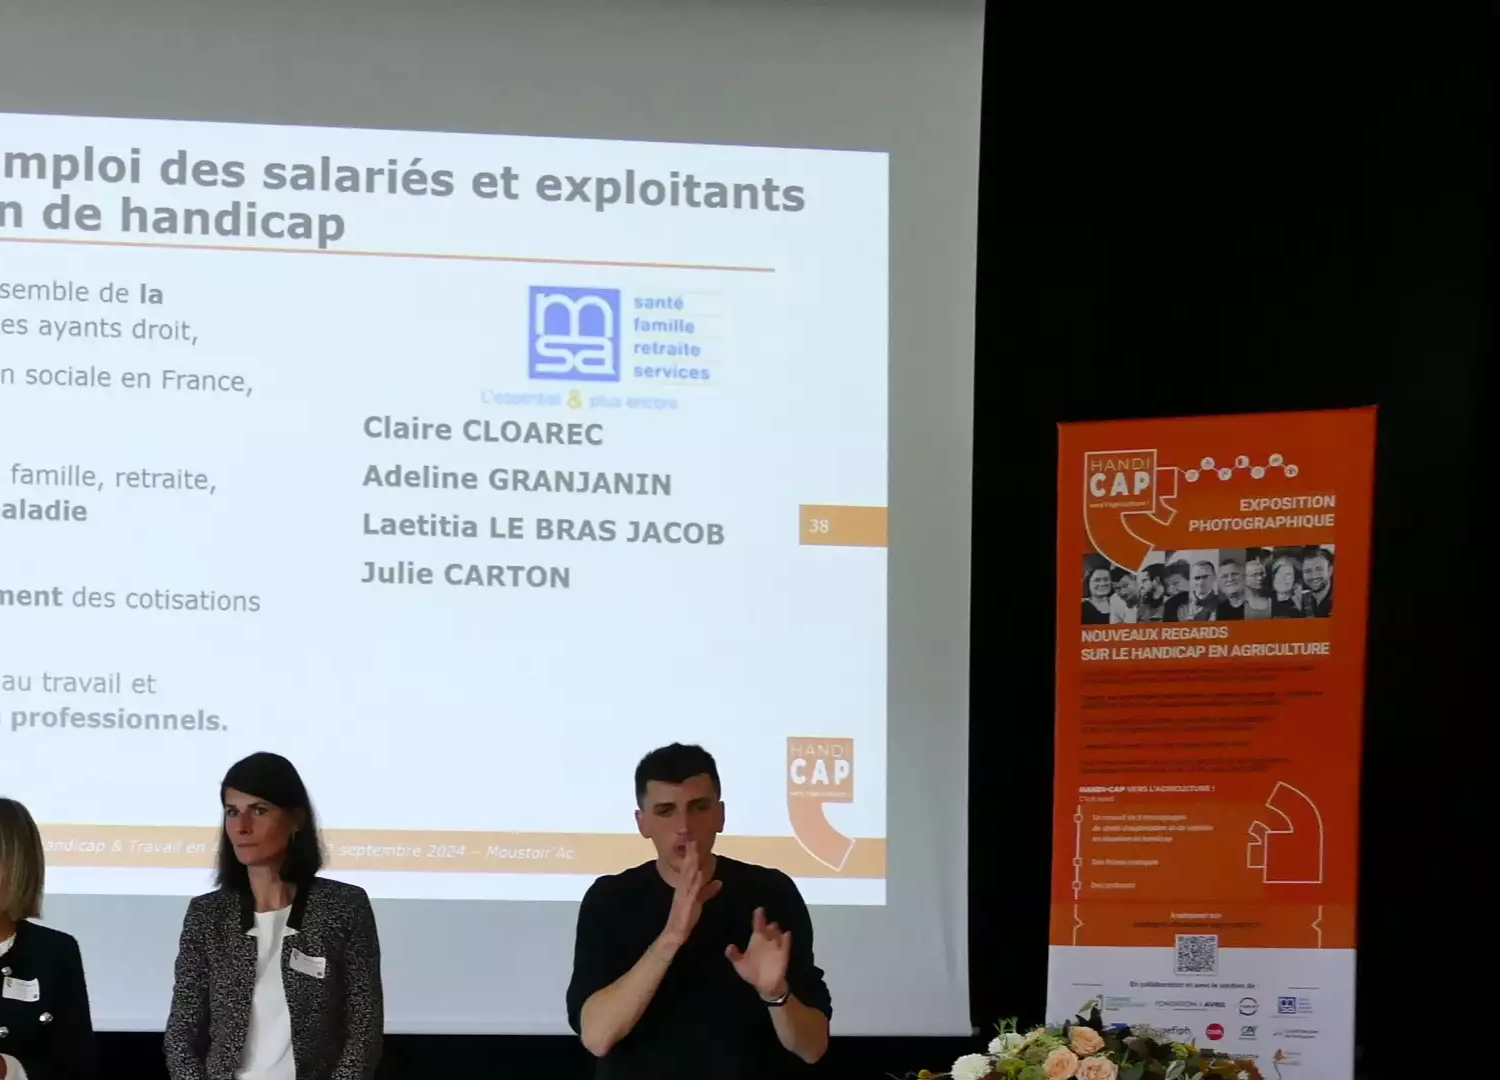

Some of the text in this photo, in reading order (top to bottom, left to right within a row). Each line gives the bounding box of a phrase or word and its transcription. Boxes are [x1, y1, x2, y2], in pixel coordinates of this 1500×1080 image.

[160, 149, 246, 189] des
[262, 155, 455, 197] salariés
[471, 166, 520, 200] et
[535, 168, 806, 213] exploitants
[42, 193, 102, 232] de
[121, 196, 345, 250] handicap
[99, 282, 129, 304] de
[140, 283, 163, 305] la
[633, 296, 685, 311] santé
[39, 318, 122, 341] ayants
[132, 318, 198, 346] droit,
[633, 318, 695, 334] famille
[633, 341, 702, 356] retraite
[25, 365, 111, 388] sociale
[121, 371, 151, 389] en
[162, 369, 252, 397] France,
[633, 364, 711, 380] services
[566, 389, 582, 409] &
[363, 415, 603, 446] Claire CLOAREC
[1090, 457, 1150, 472] HANDI
[11, 462, 104, 492] famille,
[116, 468, 216, 495] retraite,
[362, 463, 671, 496] Adeline GRANJANIN
[1090, 470, 1150, 497] CAP
[1239, 494, 1336, 512] EXPOSITION
[363, 512, 725, 546] Laetitia LE BRAS JACOB
[808, 518, 829, 534] 38
[1188, 513, 1335, 532] PHOTOGRAPHIQUE
[360, 560, 570, 589] Julie CARTON
[72, 586, 116, 609] des
[125, 589, 261, 612] cotisations
[1081, 626, 1229, 643] NOUVEAUX REGARDS
[1080, 642, 1330, 661] SUR LE HANDICAP EN AGRICULTURE
[2, 674, 31, 692] au
[42, 672, 120, 694] travail
[131, 674, 156, 694] et
[11, 706, 227, 732] professionnels.
[791, 742, 849, 757] HANDI
[790, 757, 850, 785] CAP
[41, 838, 106, 854] andicap
[111, 839, 122, 853] &
[129, 839, 182, 854] Travail
[186, 843, 206, 854] en
[338, 843, 422, 860] septembre
[426, 844, 467, 858] 2024
